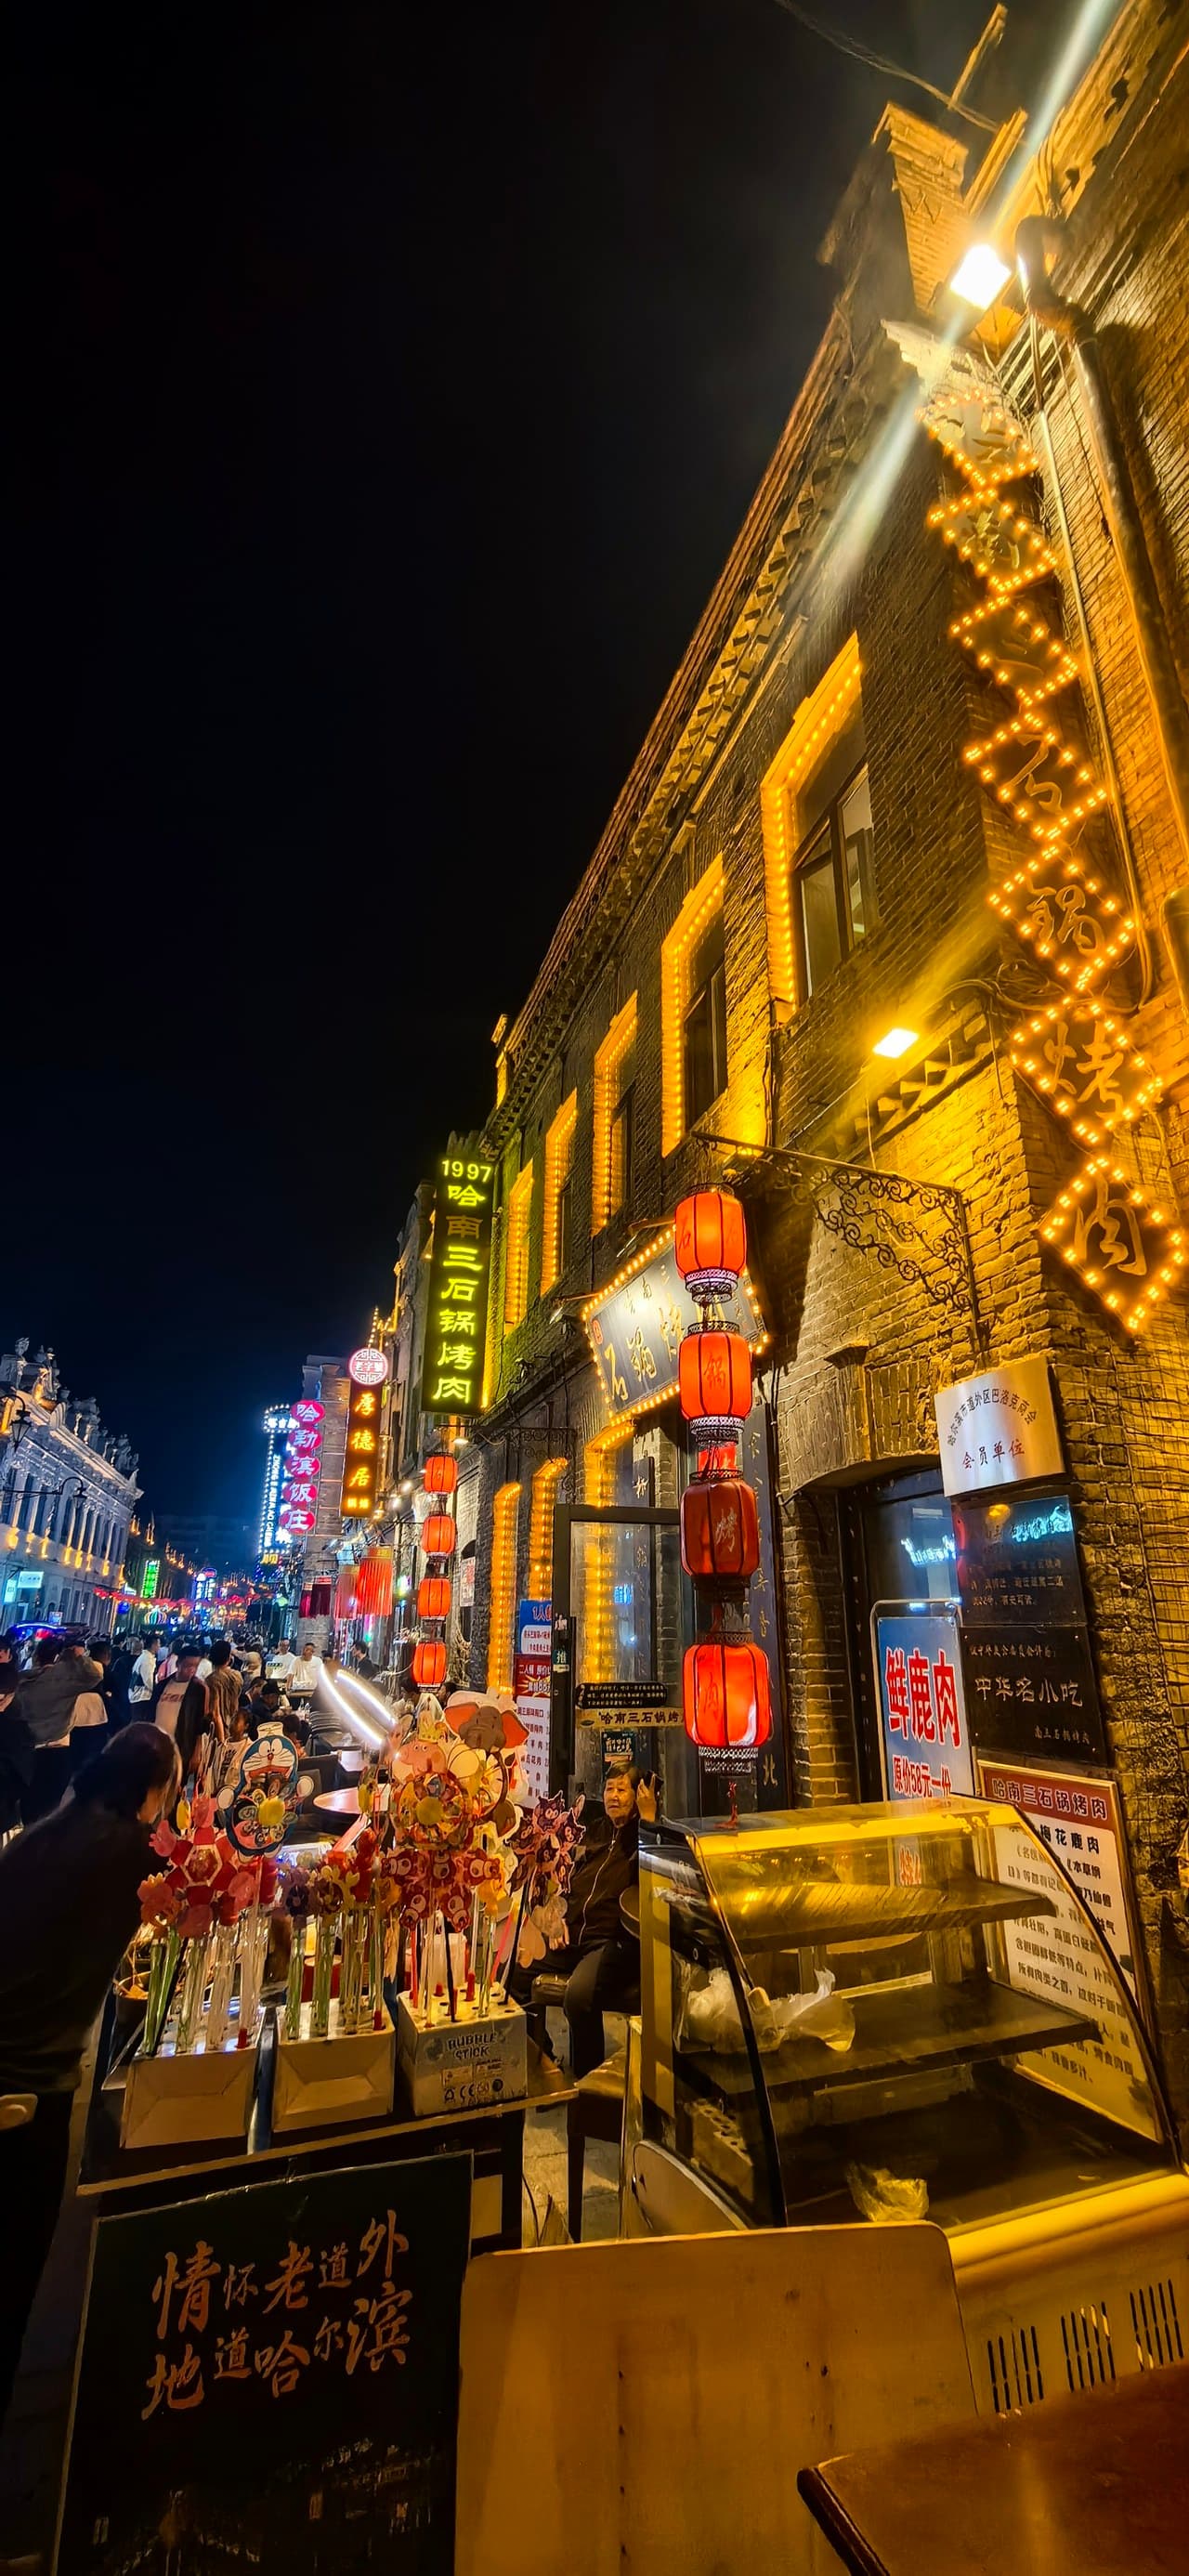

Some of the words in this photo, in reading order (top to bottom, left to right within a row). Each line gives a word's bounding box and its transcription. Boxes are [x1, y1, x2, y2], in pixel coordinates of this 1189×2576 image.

[441, 1159, 491, 1183] 1997
[433, 1184, 486, 1405] 哈南三石锅烤肉
[348, 1393, 375, 1487] 厚德居
[962, 1438, 1025, 1469] 会员单位
[885, 1646, 962, 1750] 鲜鹿肉
[974, 1676, 1083, 1707] 中华名小吃
[598, 1711, 685, 1725] 哈南三石锅烤
[991, 1777, 1107, 1821] 哈南三石锅烤肉
[454, 2045, 490, 2060] STICK
[150, 2208, 410, 2339] 情怀老道外
[140, 2281, 413, 2421] 地道哈尔滨
